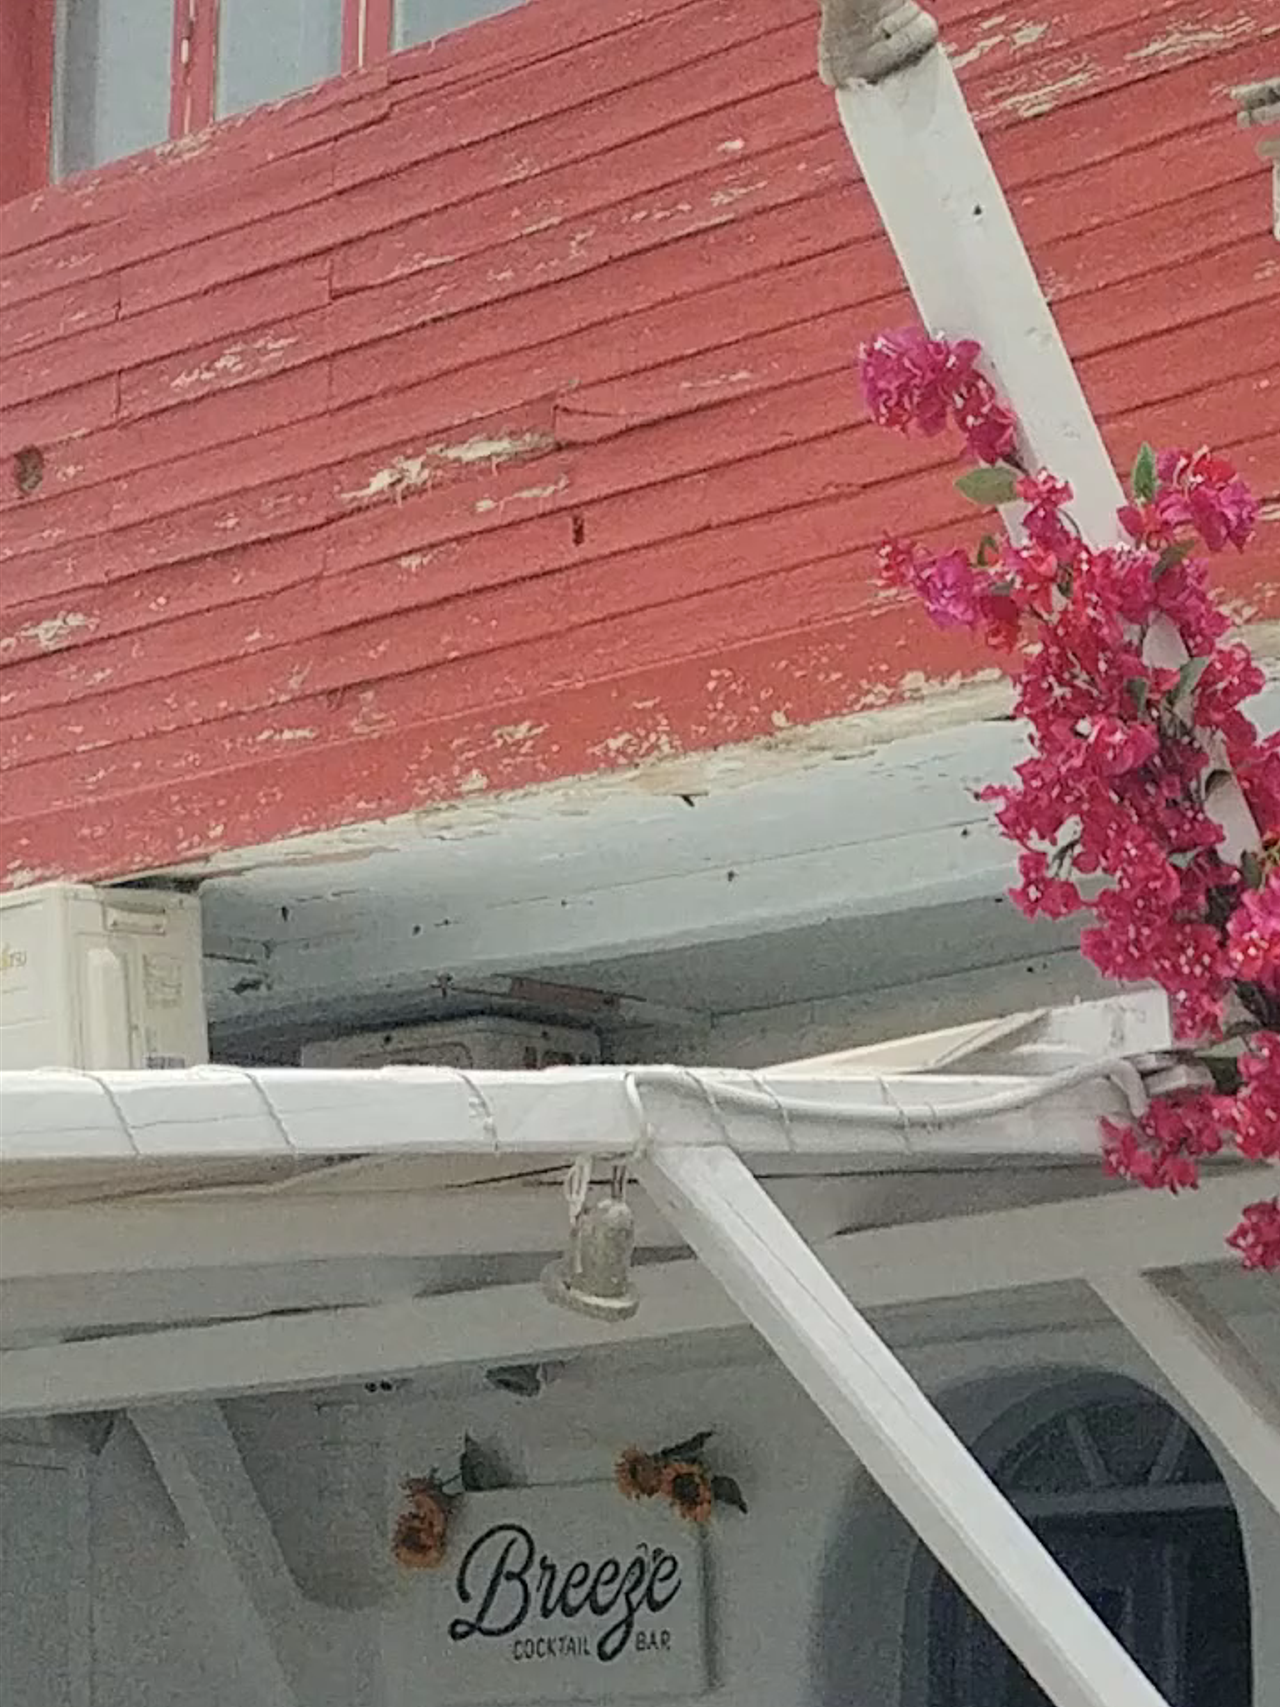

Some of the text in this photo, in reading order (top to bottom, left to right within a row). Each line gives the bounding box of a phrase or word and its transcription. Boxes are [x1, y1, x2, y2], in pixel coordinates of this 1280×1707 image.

[448, 1524, 682, 1661] Breeze
[513, 1630, 671, 1660] COCKTAIL BAR
